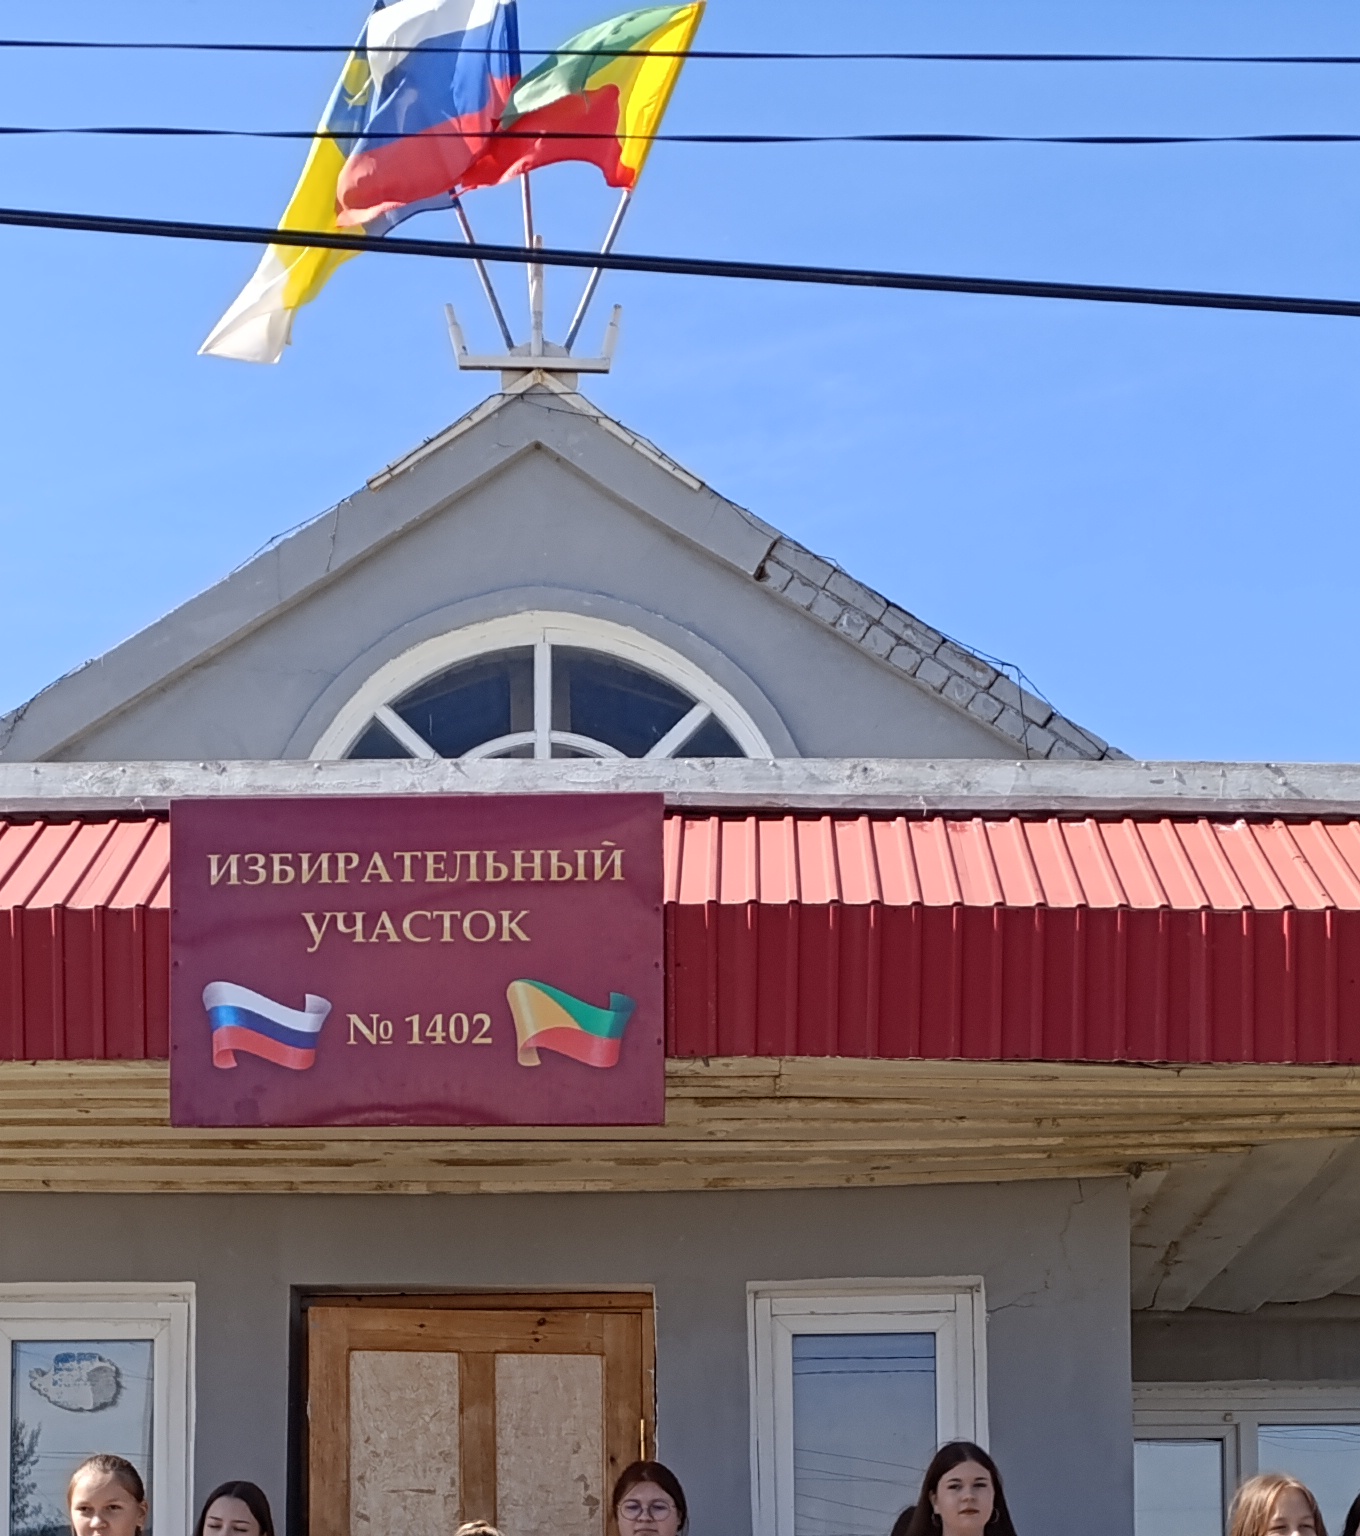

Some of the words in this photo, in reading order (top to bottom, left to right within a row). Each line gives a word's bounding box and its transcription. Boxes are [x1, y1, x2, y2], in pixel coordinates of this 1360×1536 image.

[207, 841, 626, 886] ИЗБИРАТЕЛЬНЫЙ
[301, 909, 532, 953] УЧАСТОК
[345, 1012, 394, 1046] №
[405, 1012, 493, 1046] 1402
